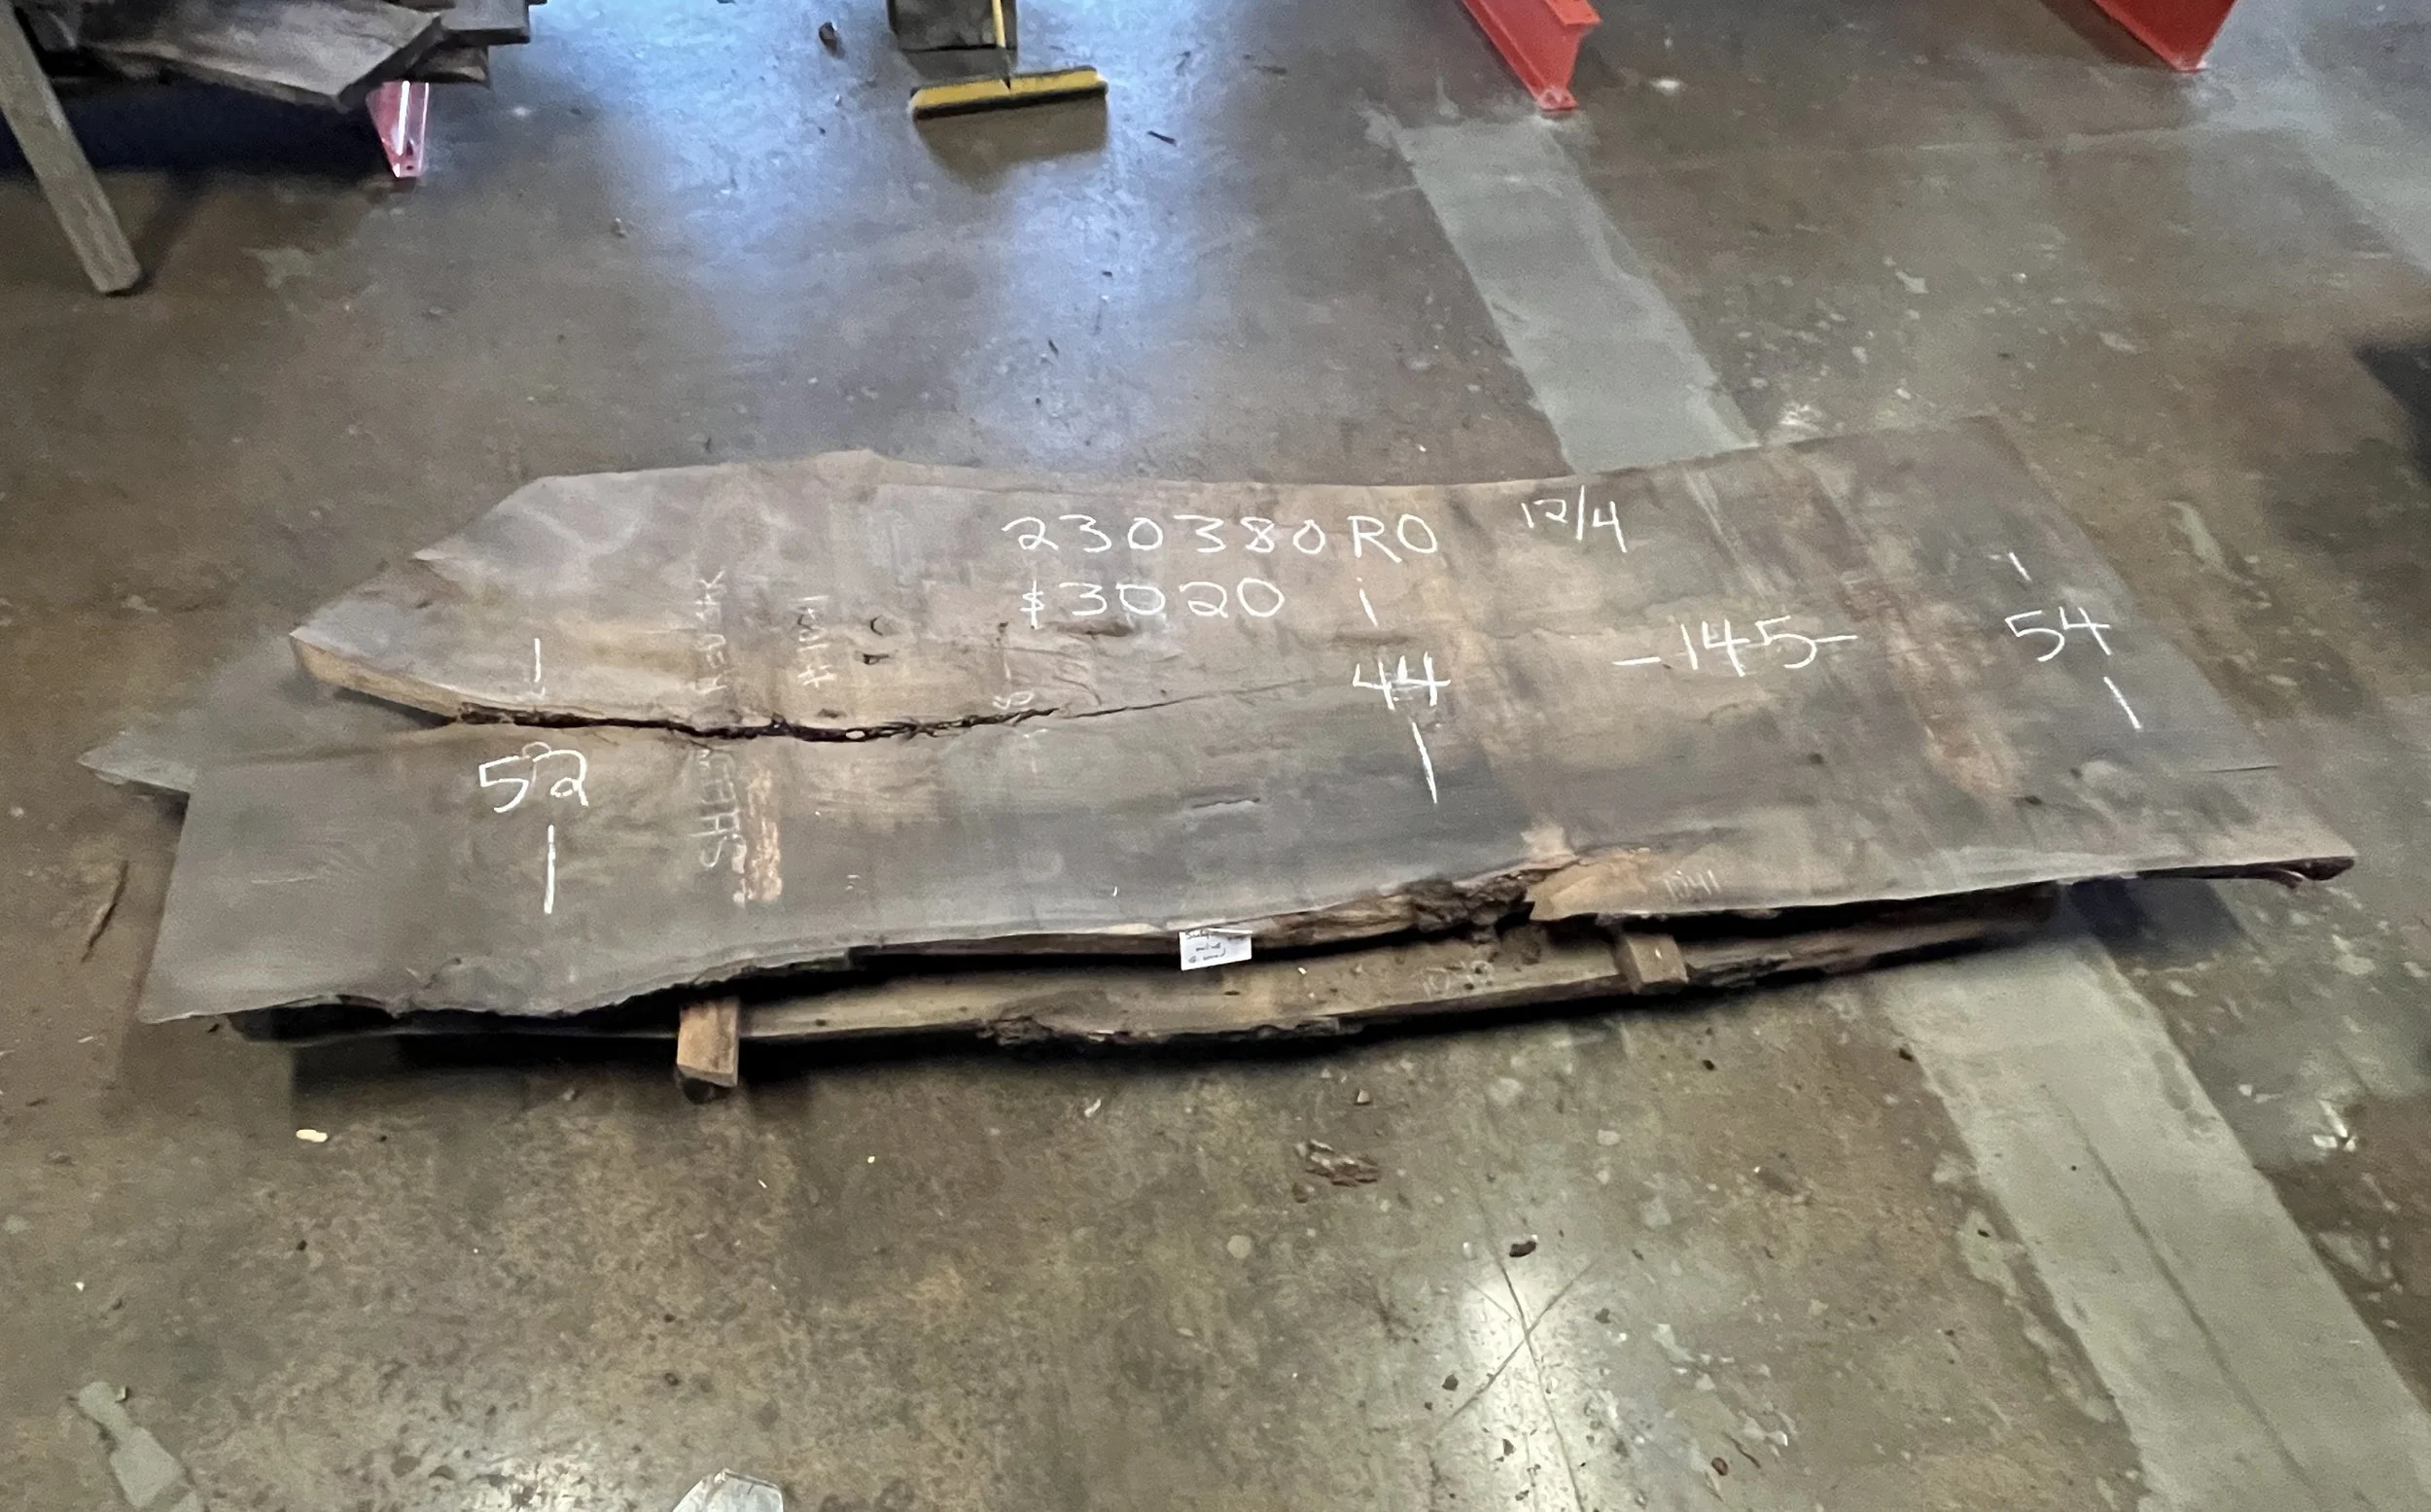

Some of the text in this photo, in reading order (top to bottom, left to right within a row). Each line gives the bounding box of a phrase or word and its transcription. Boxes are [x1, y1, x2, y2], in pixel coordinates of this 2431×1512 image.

[1001, 512, 1439, 564] 230380 RO
[1520, 484, 1628, 553] 12/4
[1020, 579, 1286, 630] $3020
[2004, 606, 2113, 662] 54
[1352, 651, 1452, 711] 44
[478, 747, 589, 814] 52
